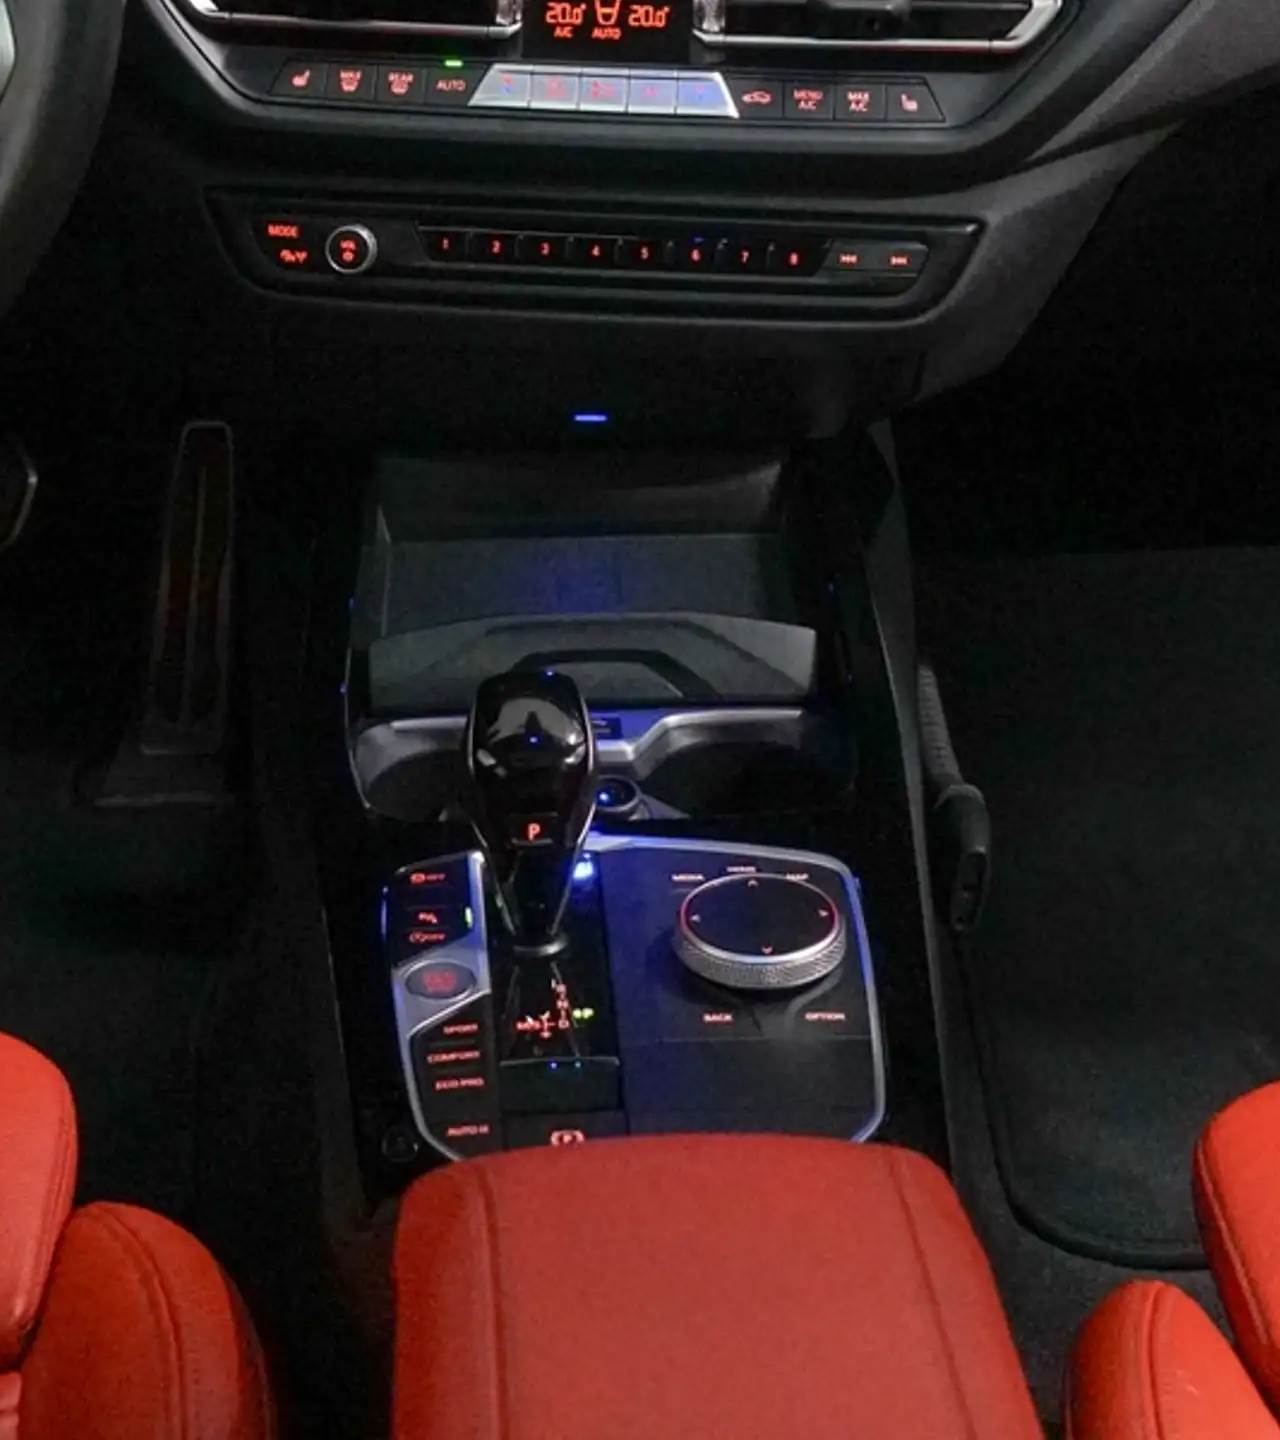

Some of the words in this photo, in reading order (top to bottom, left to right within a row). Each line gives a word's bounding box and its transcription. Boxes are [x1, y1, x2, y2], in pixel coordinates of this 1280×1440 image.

[436, 79, 466, 92] AUTO
[267, 224, 299, 238] MODE
[492, 240, 501, 254] 2
[540, 242, 551, 255] 3
[591, 244, 601, 257] 4
[691, 248, 701, 261] 6
[741, 250, 751, 262] 7
[528, 823, 541, 841] P
[804, 1011, 847, 1022] OPTION
[442, 1023, 479, 1034] SPORT
[426, 1050, 480, 1064] COMFORT
[460, 1077, 485, 1088] PRO
[447, 1124, 478, 1137] AUTO
